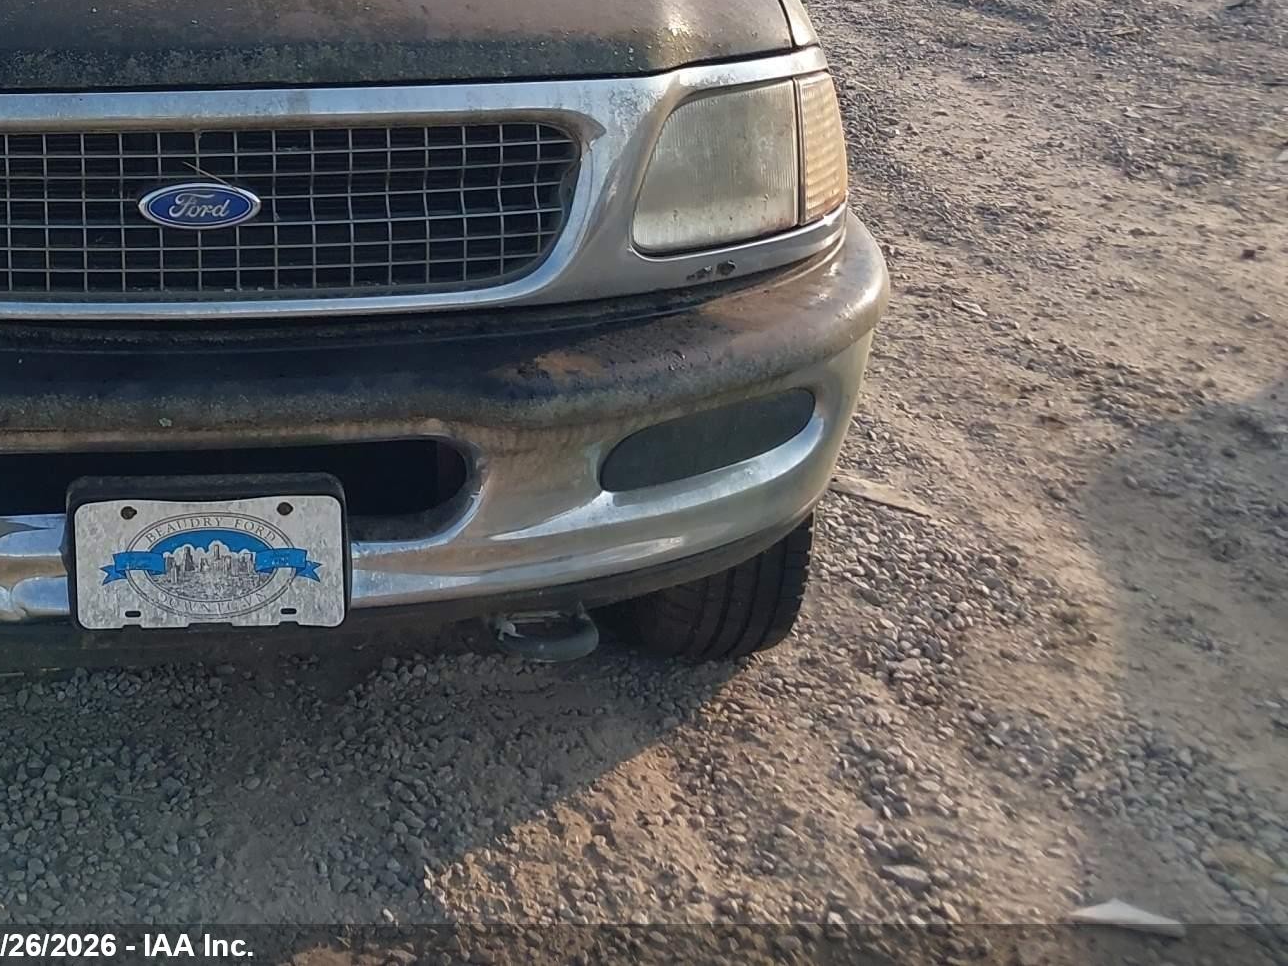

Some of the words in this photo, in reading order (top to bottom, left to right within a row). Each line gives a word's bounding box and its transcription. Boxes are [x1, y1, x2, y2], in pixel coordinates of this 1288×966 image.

[168, 192, 230, 218] Ford
[144, 517, 224, 543] BEAUDRY
[234, 518, 277, 542] FORD
